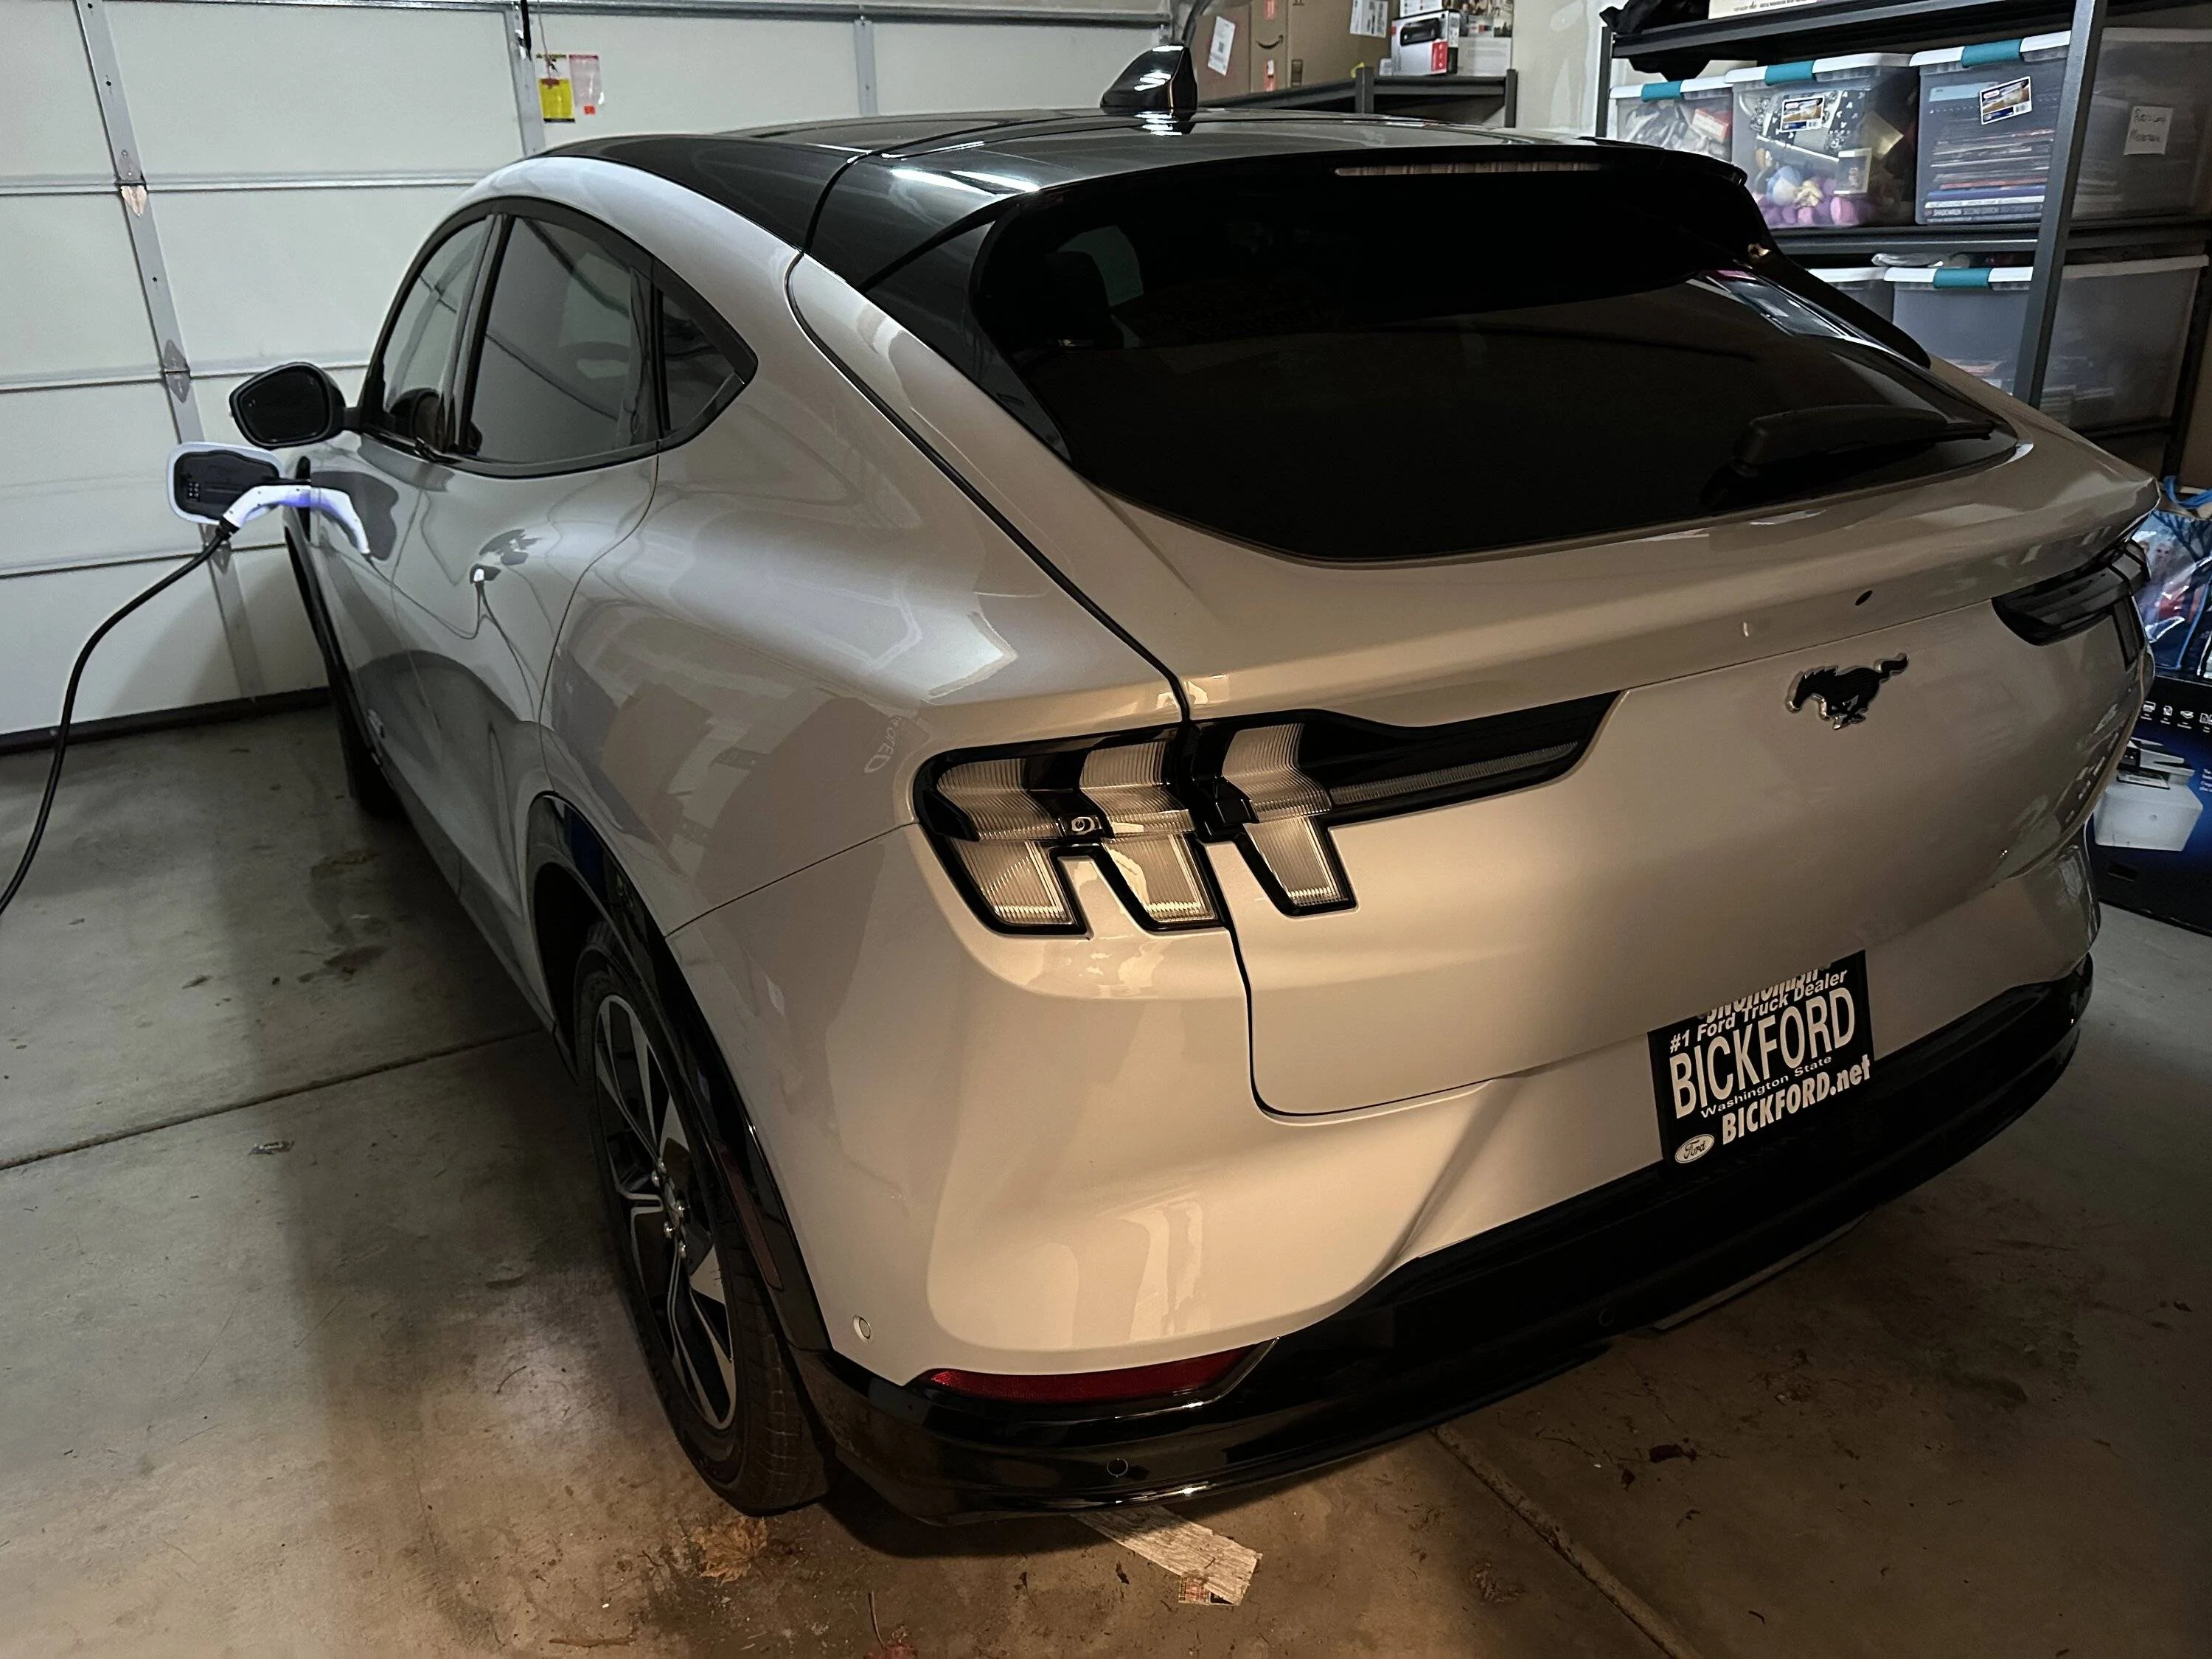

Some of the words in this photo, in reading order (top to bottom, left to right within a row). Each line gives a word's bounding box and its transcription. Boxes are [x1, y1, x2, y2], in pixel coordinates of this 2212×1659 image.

[1669, 987, 1855, 1119] BICKFORD
[1670, 1029, 1691, 1054] #1
[1697, 1012, 1735, 1041] Ford
[1742, 992, 1789, 1023] Truck
[1793, 970, 1848, 1002] Dealer
[1700, 1074, 1790, 1119] Washington
[1794, 1055, 1832, 1077] State
[1722, 1054, 1871, 1145] BICKFORD.net
